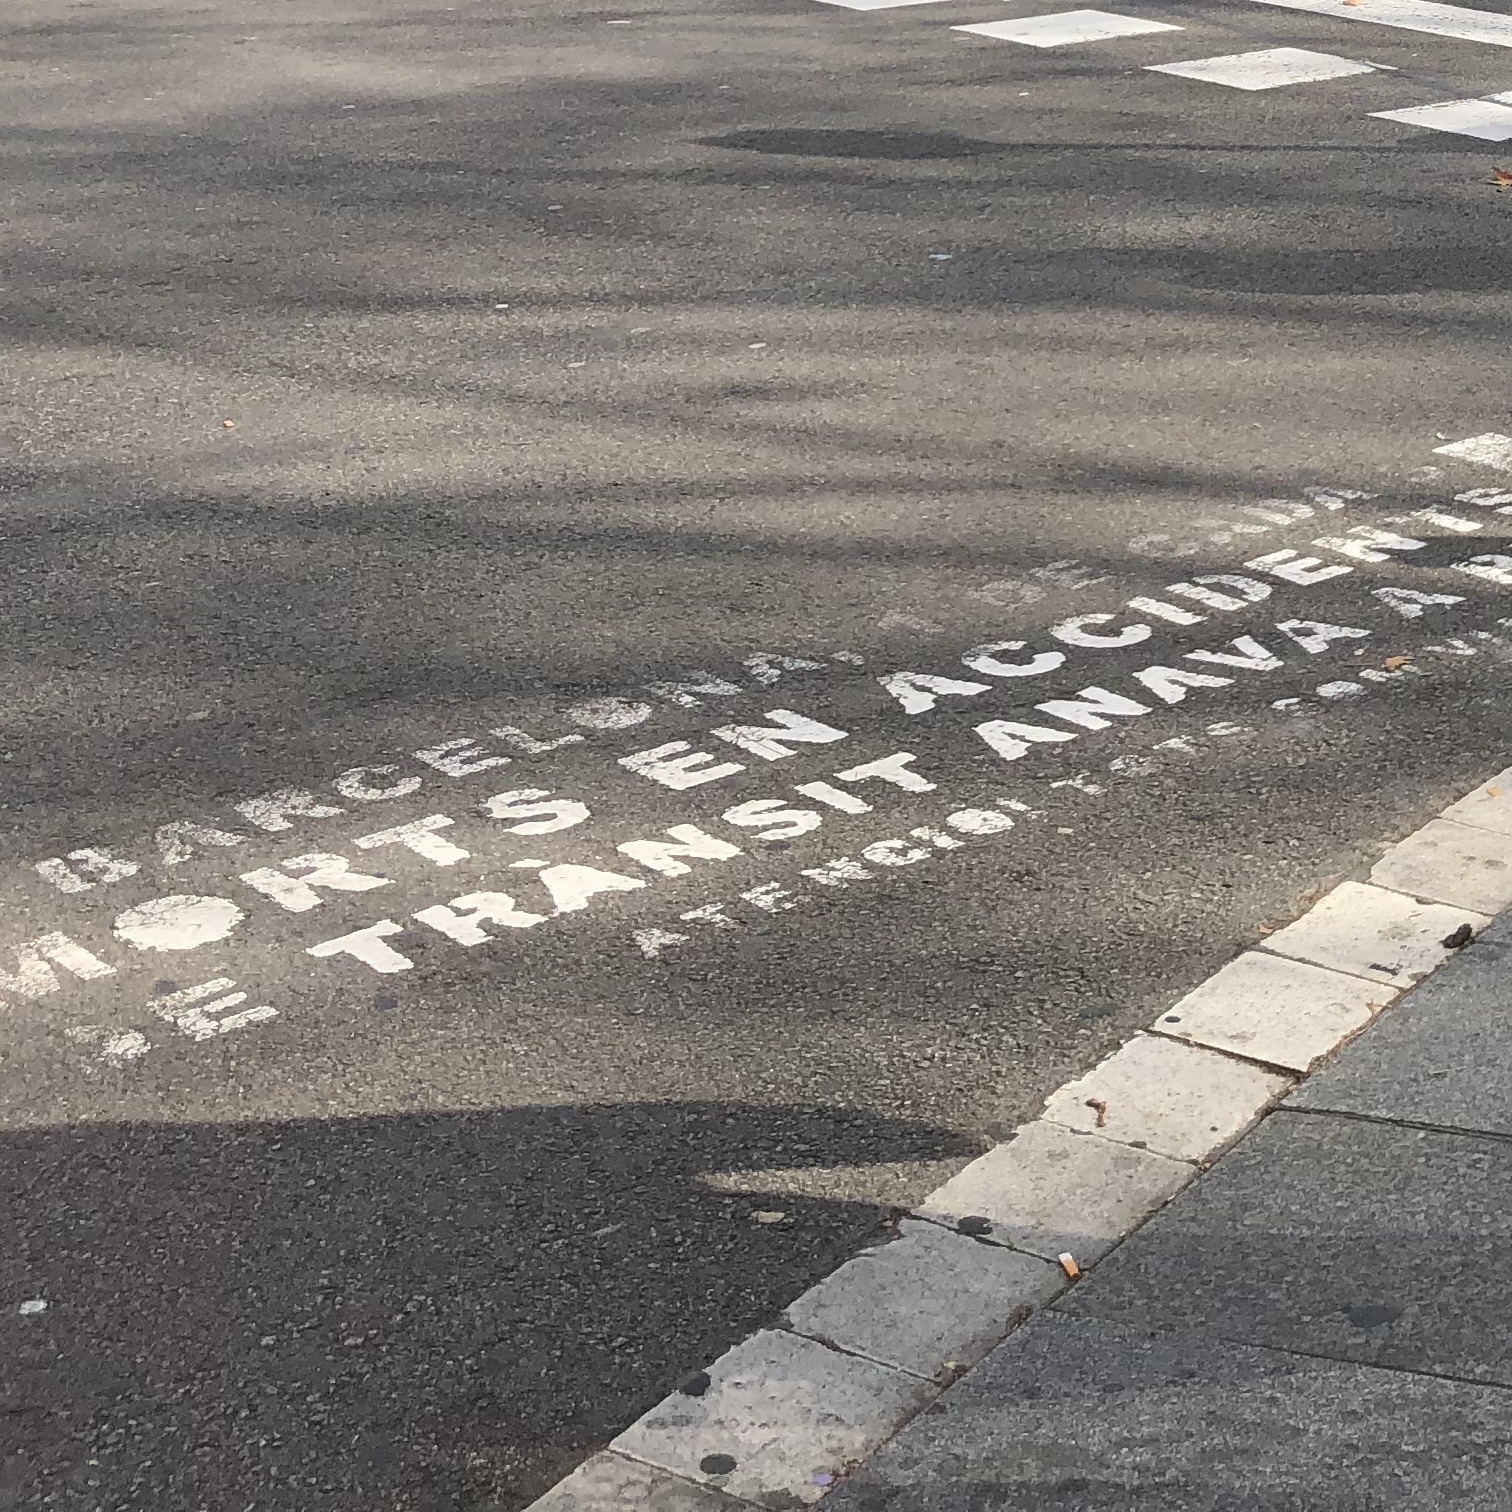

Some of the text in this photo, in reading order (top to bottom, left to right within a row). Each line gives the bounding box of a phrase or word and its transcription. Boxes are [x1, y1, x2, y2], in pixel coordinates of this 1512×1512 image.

[971, 617, 1373, 761] ANAVA
[1371, 586, 1466, 621] A
[617, 707, 850, 790] EN
